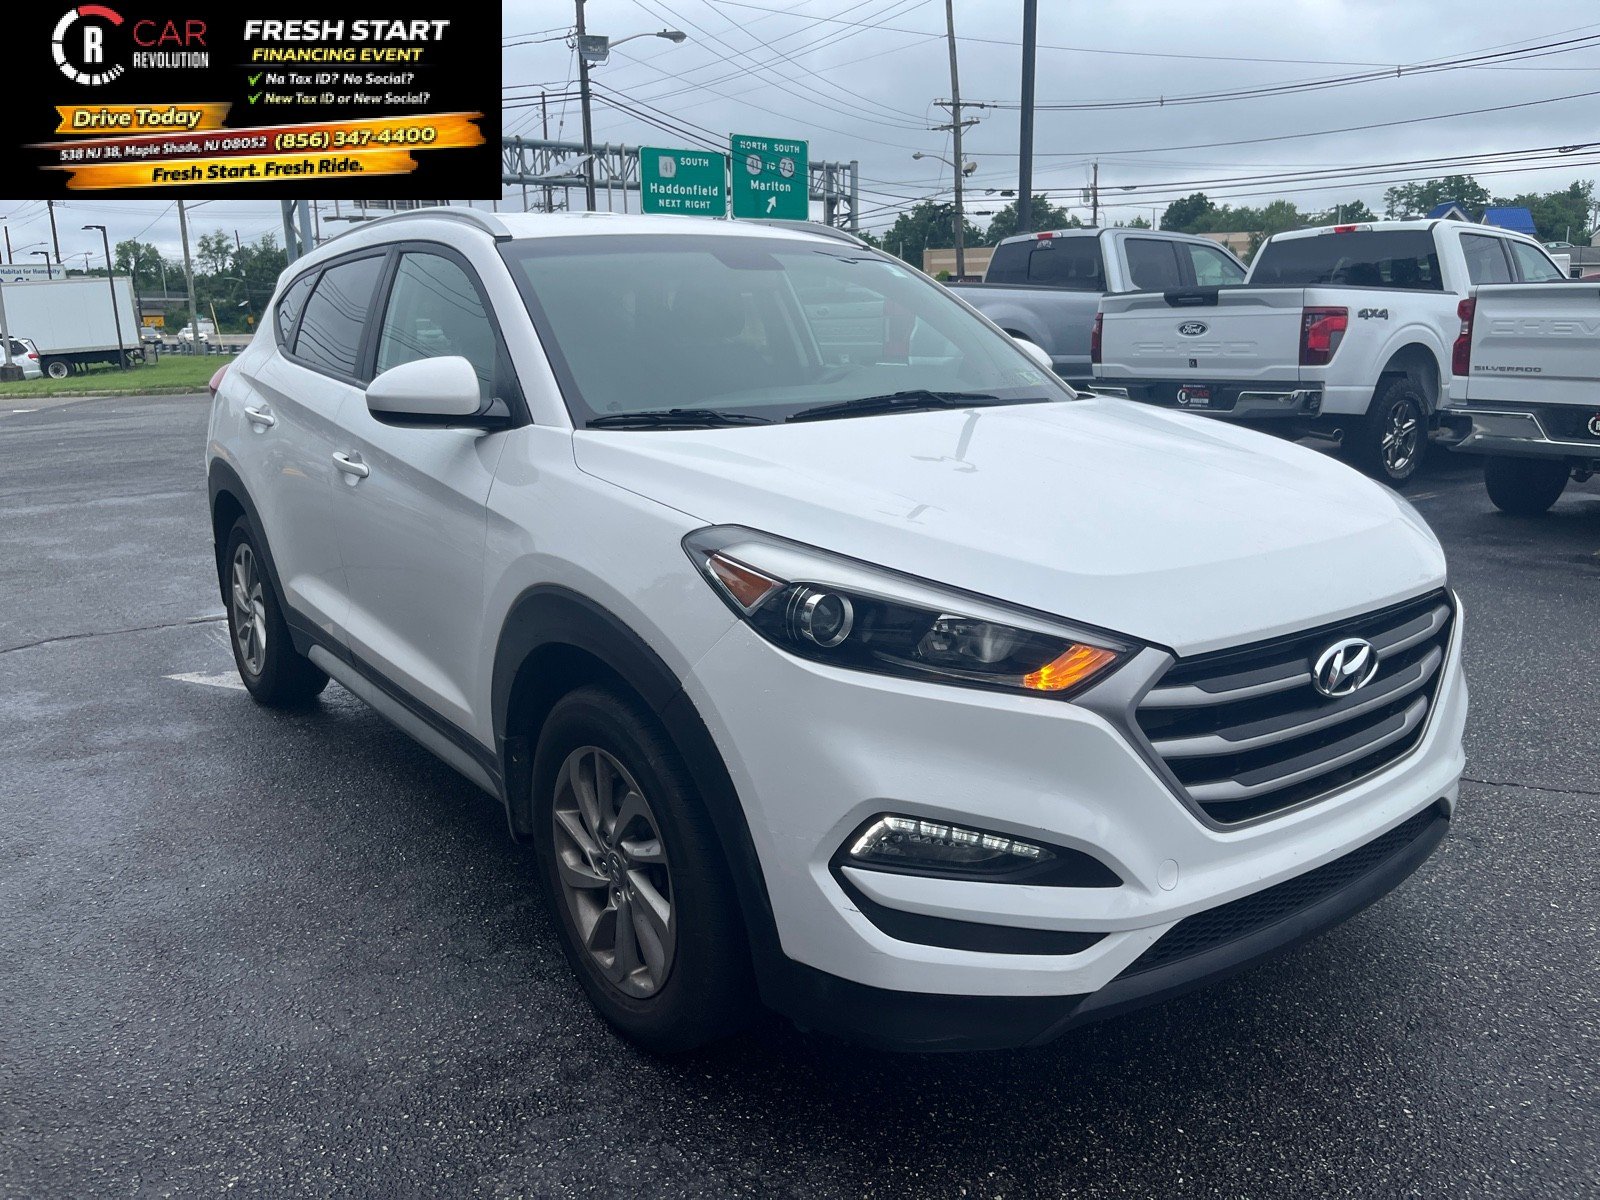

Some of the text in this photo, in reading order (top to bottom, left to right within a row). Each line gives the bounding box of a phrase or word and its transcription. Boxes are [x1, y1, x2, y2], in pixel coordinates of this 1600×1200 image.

[739, 141, 800, 154] NORTH SOUTH
[662, 161, 673, 173] 41
[680, 157, 709, 167] SOUTH
[780, 162, 793, 173] 73
[650, 182, 719, 197] Haddonfield
[750, 180, 791, 192] Marlton
[658, 199, 711, 209] NEXT RIGHT
[1182, 324, 1201, 335] Ford
[1131, 341, 1258, 357] F-150
[1473, 365, 1542, 373] SILVERADO
